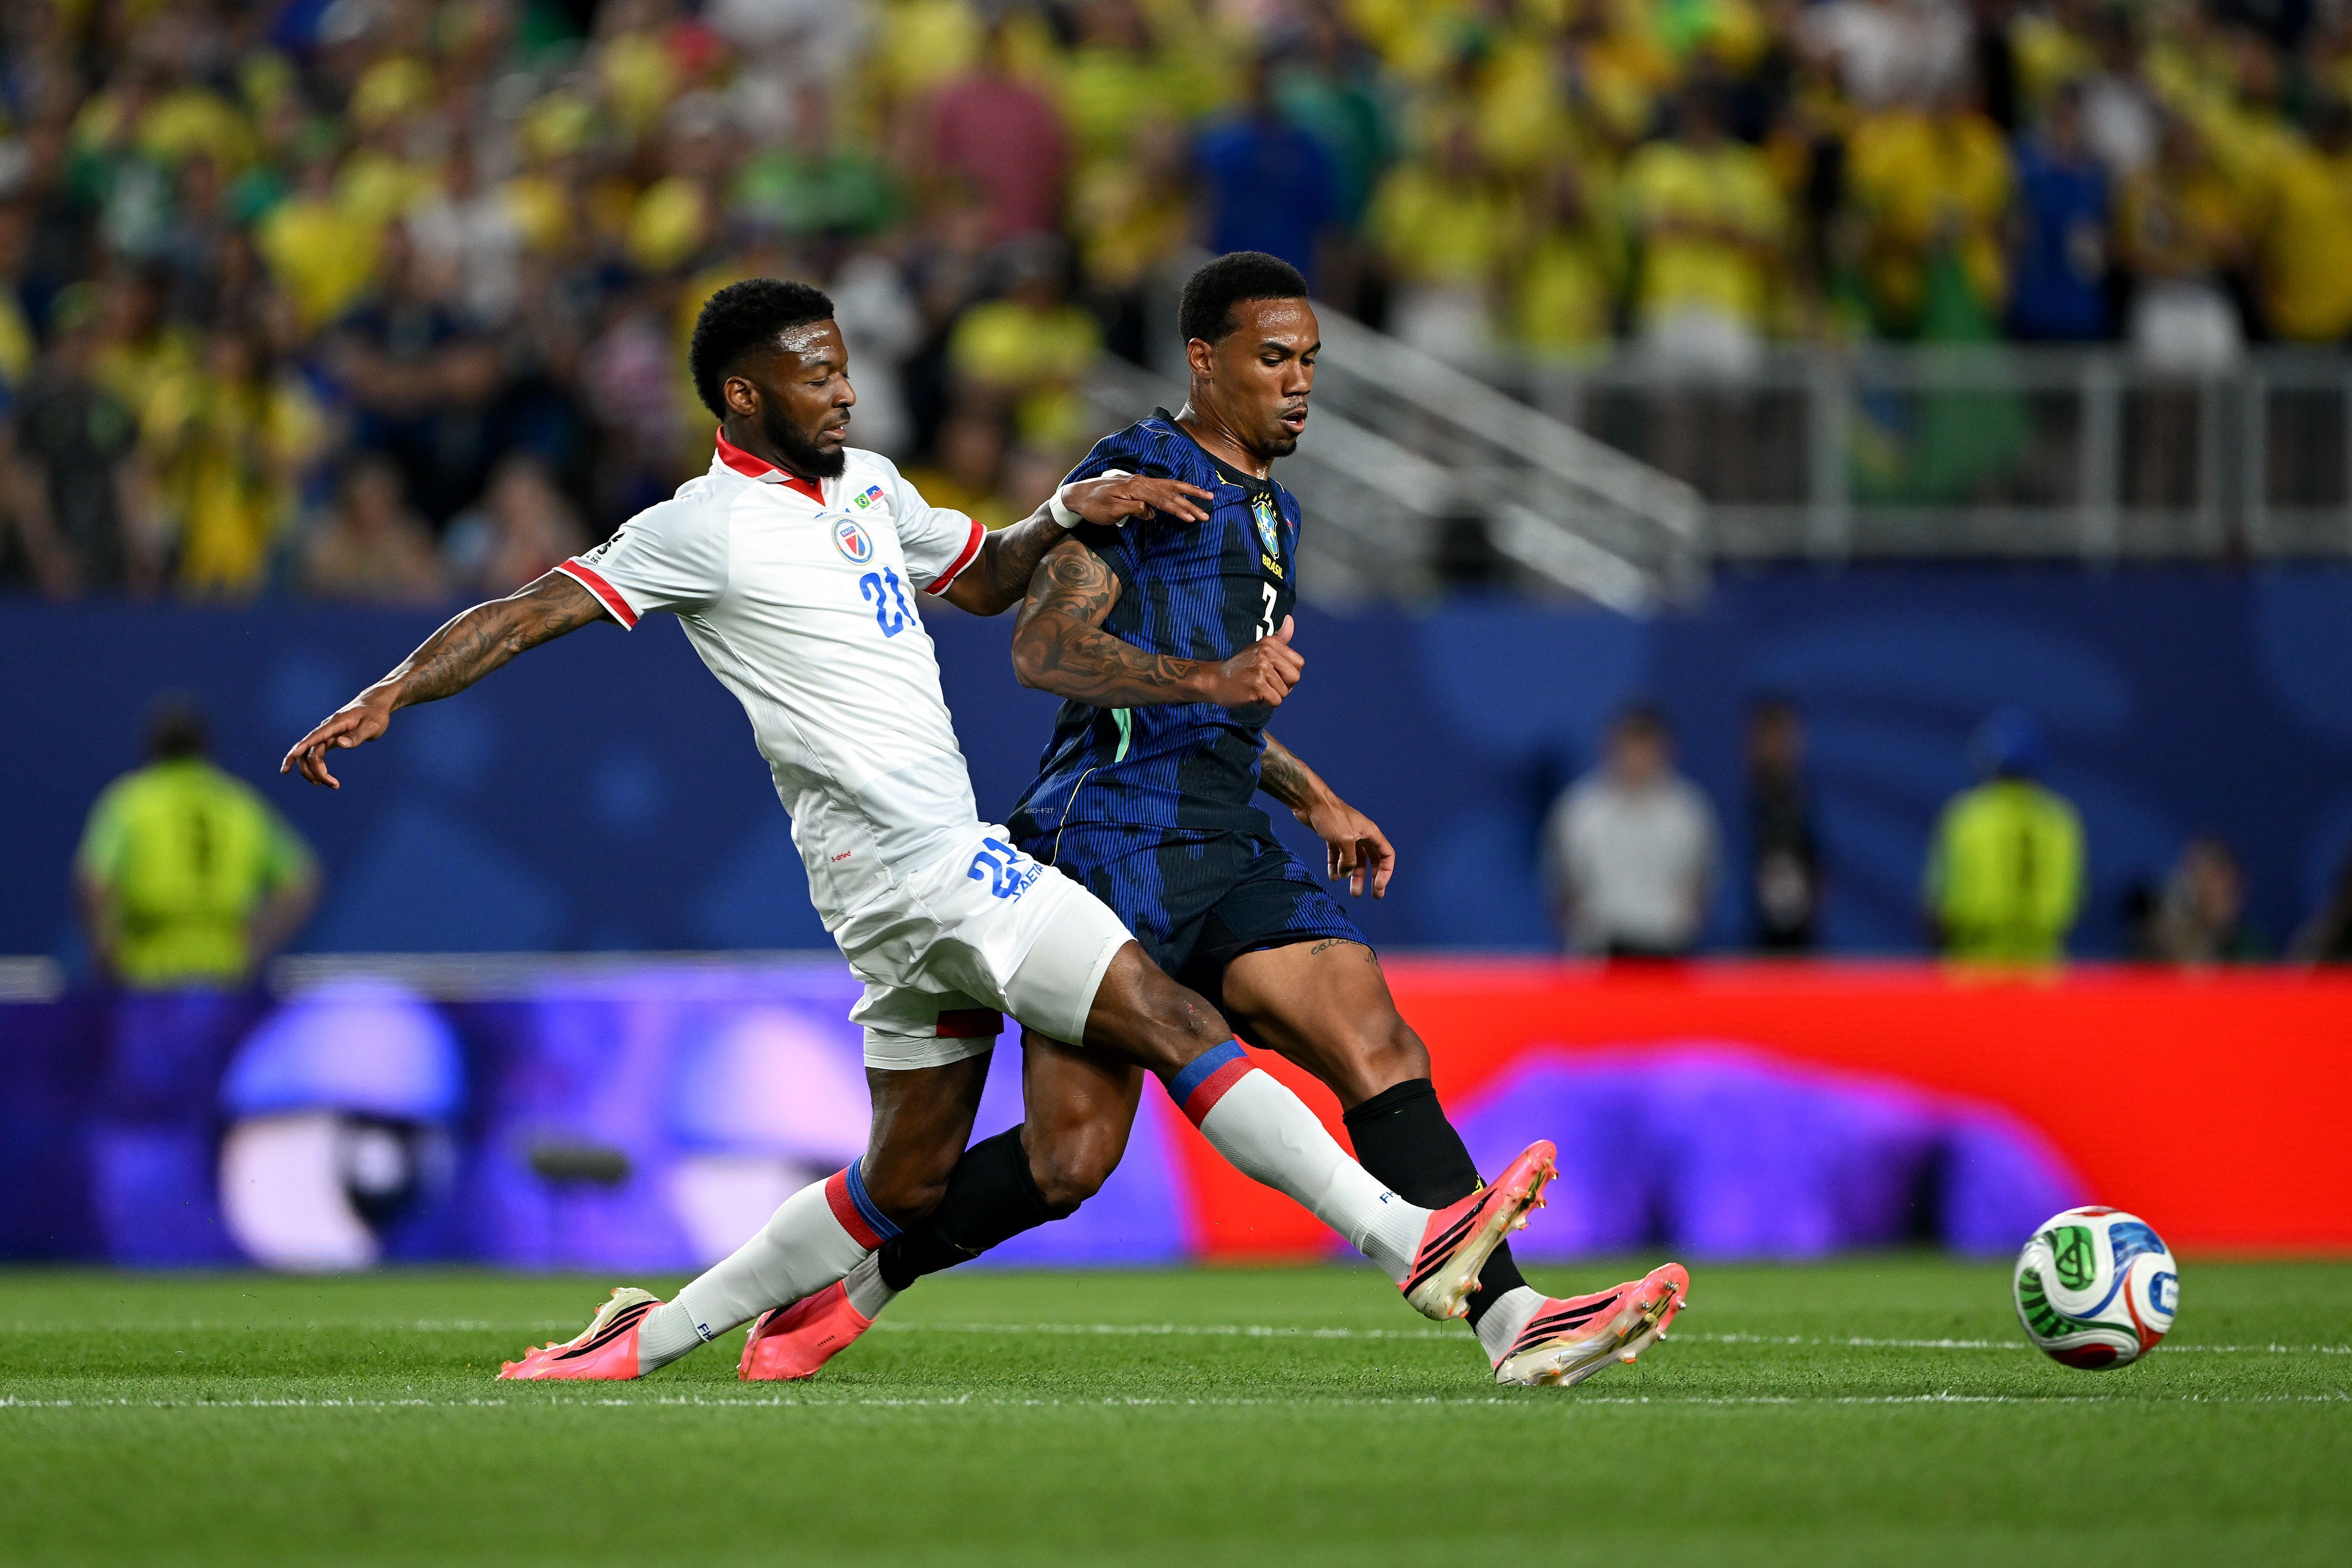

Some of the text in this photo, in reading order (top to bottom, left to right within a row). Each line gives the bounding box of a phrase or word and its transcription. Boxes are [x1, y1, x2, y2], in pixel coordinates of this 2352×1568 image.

[1262, 554, 1283, 579] BRASIL
[859, 566, 916, 638] 21
[1256, 581, 1277, 641] 3
[831, 850, 851, 862] S-dried
[967, 837, 1026, 898] 21
[1012, 863, 1044, 904] SAETA
